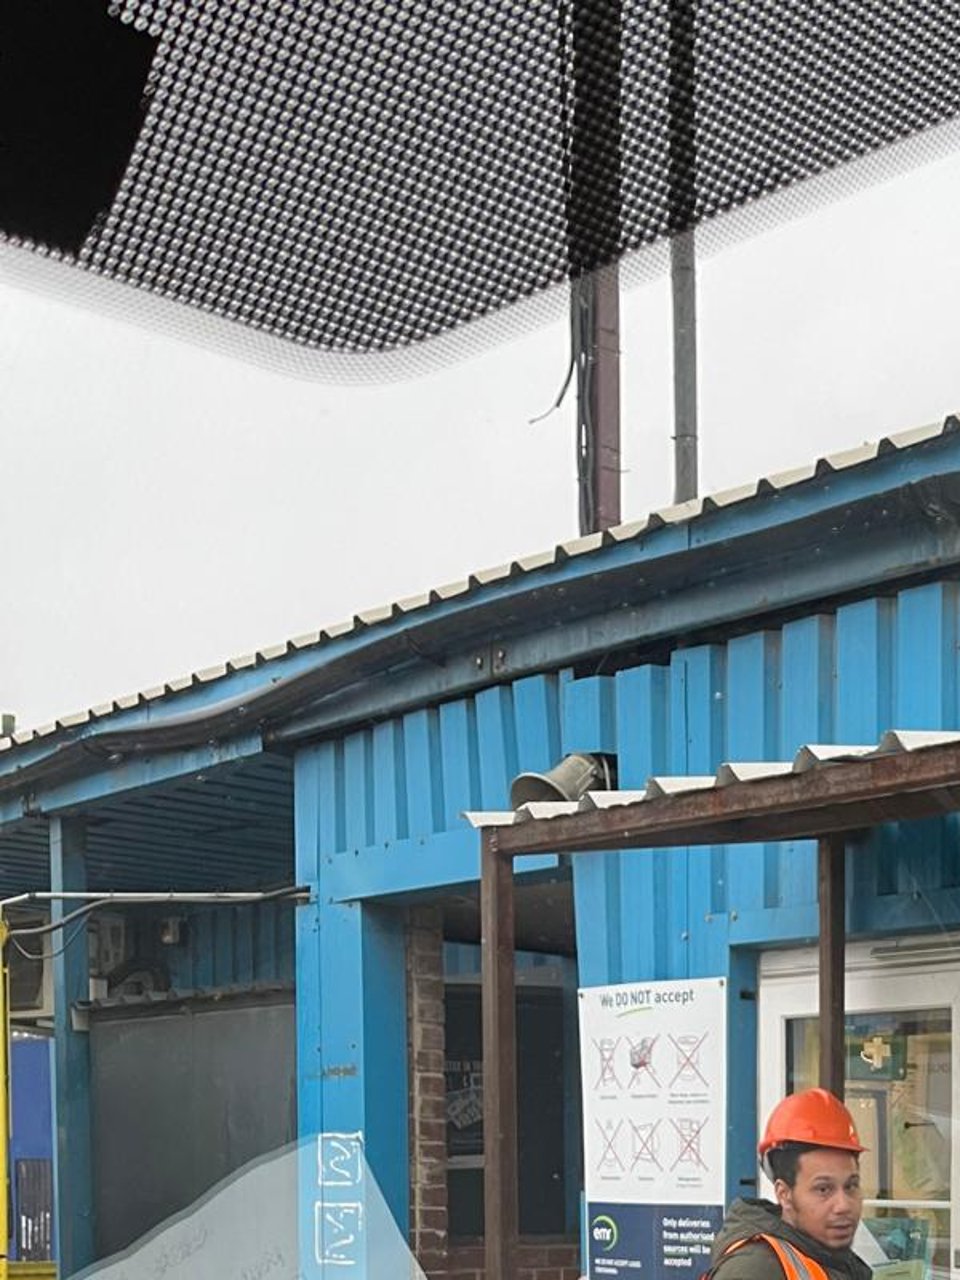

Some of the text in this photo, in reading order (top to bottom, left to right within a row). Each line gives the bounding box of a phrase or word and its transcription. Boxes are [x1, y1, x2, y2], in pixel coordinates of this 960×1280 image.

[615, 992, 628, 1006] DO
[630, 990, 651, 1005] NOT
[654, 989, 694, 1005] accept
